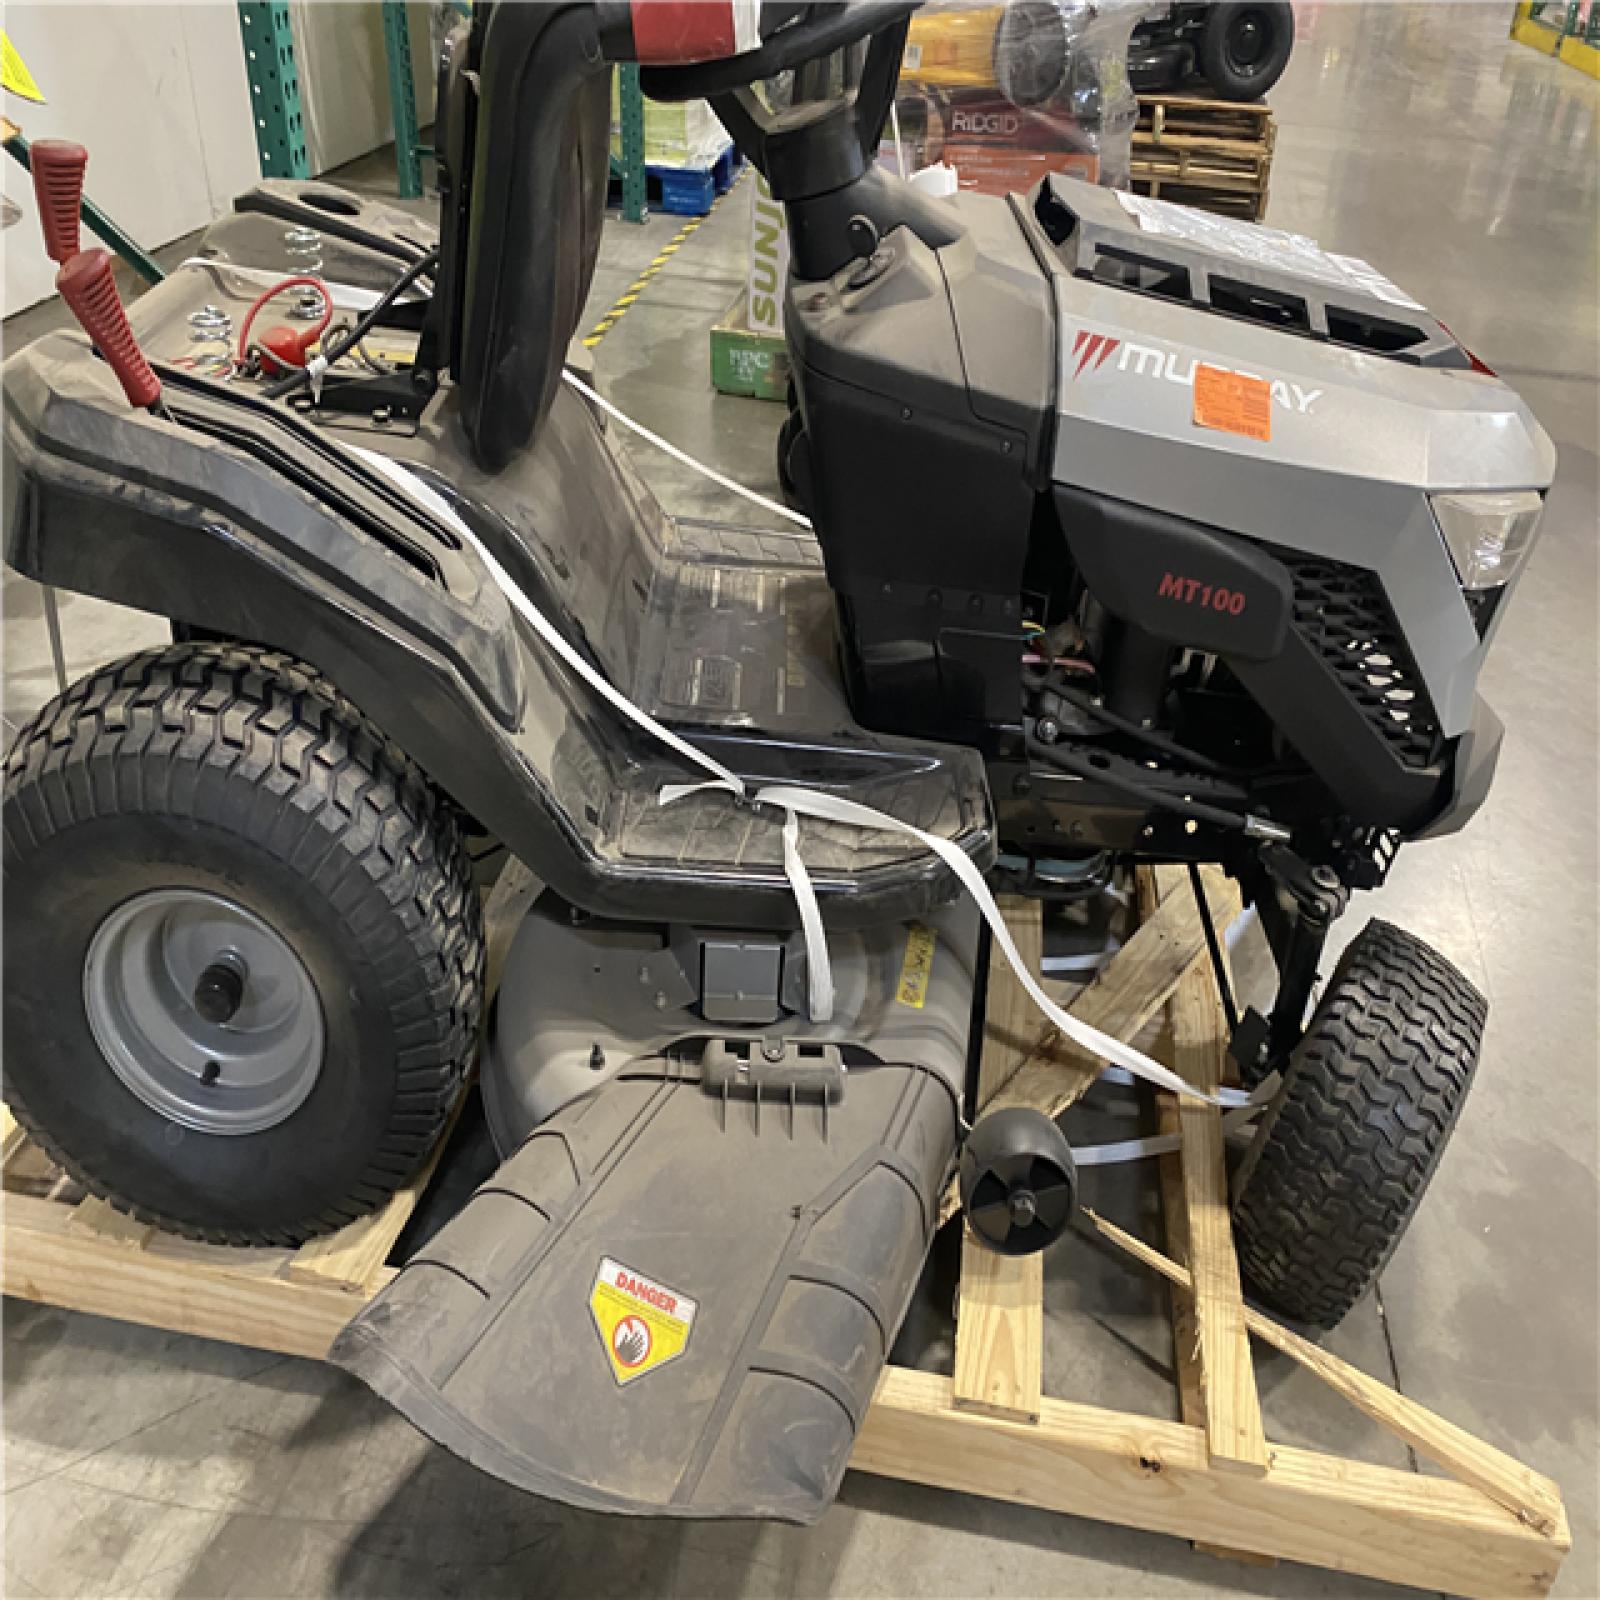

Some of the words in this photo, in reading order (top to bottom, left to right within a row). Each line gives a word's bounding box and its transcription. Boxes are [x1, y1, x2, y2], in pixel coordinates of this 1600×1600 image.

[951, 110, 1019, 133] RIDGID
[1117, 342, 1324, 414] MUAY
[1157, 572, 1246, 616] MT100
[615, 1271, 678, 1313] DANGER
